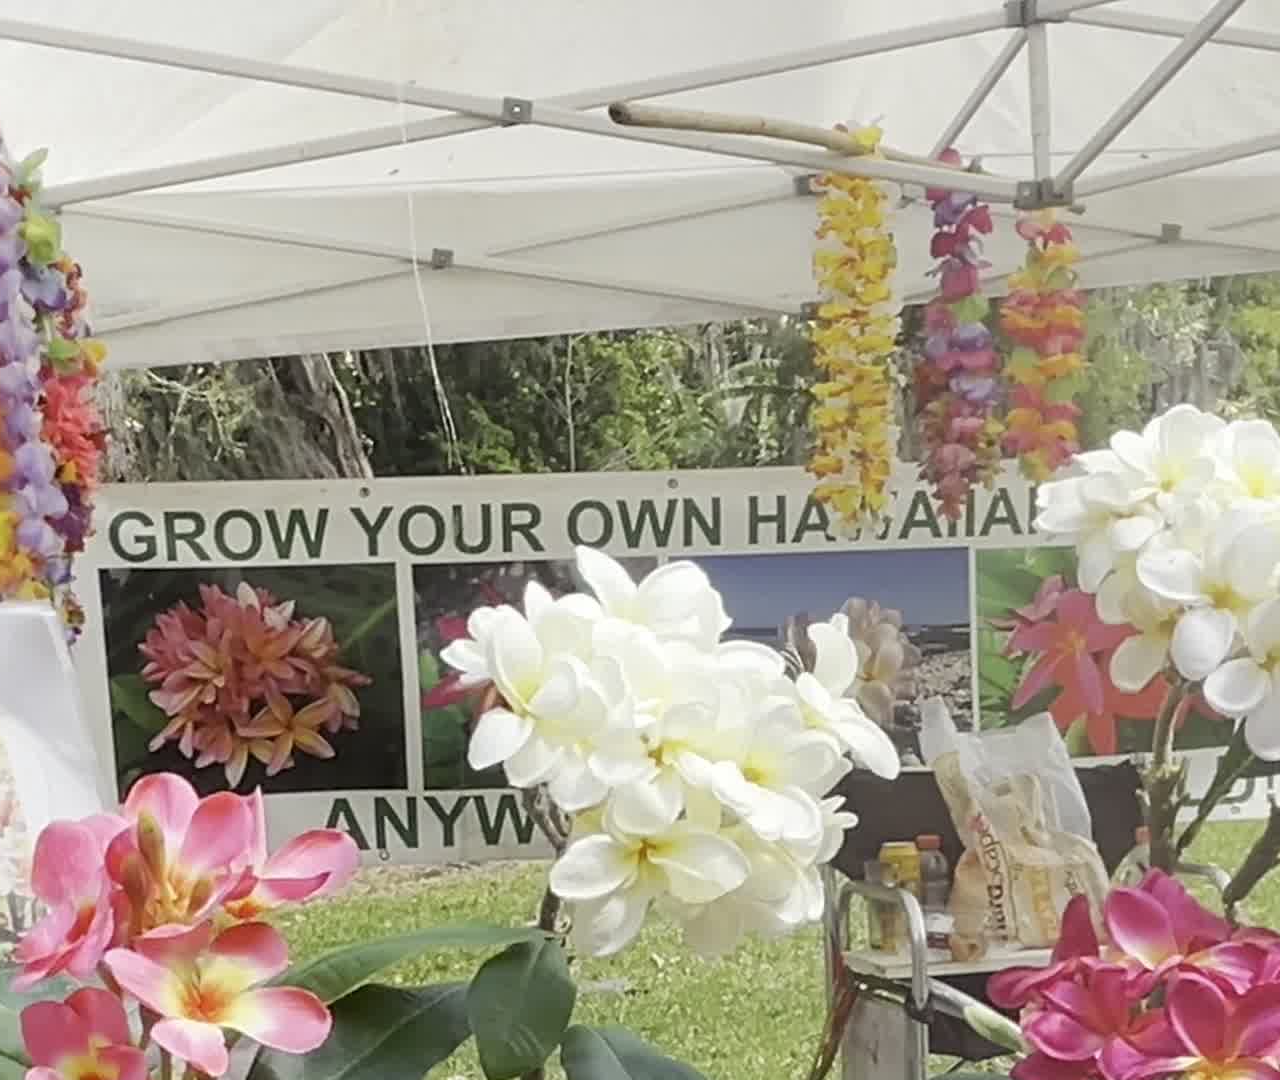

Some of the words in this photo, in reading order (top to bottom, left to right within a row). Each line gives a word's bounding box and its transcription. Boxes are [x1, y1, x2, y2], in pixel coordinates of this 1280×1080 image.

[108, 508, 330, 563] GROW
[349, 502, 546, 557] YOUR
[566, 496, 721, 549] OWN
[325, 793, 540, 851] ANYW
